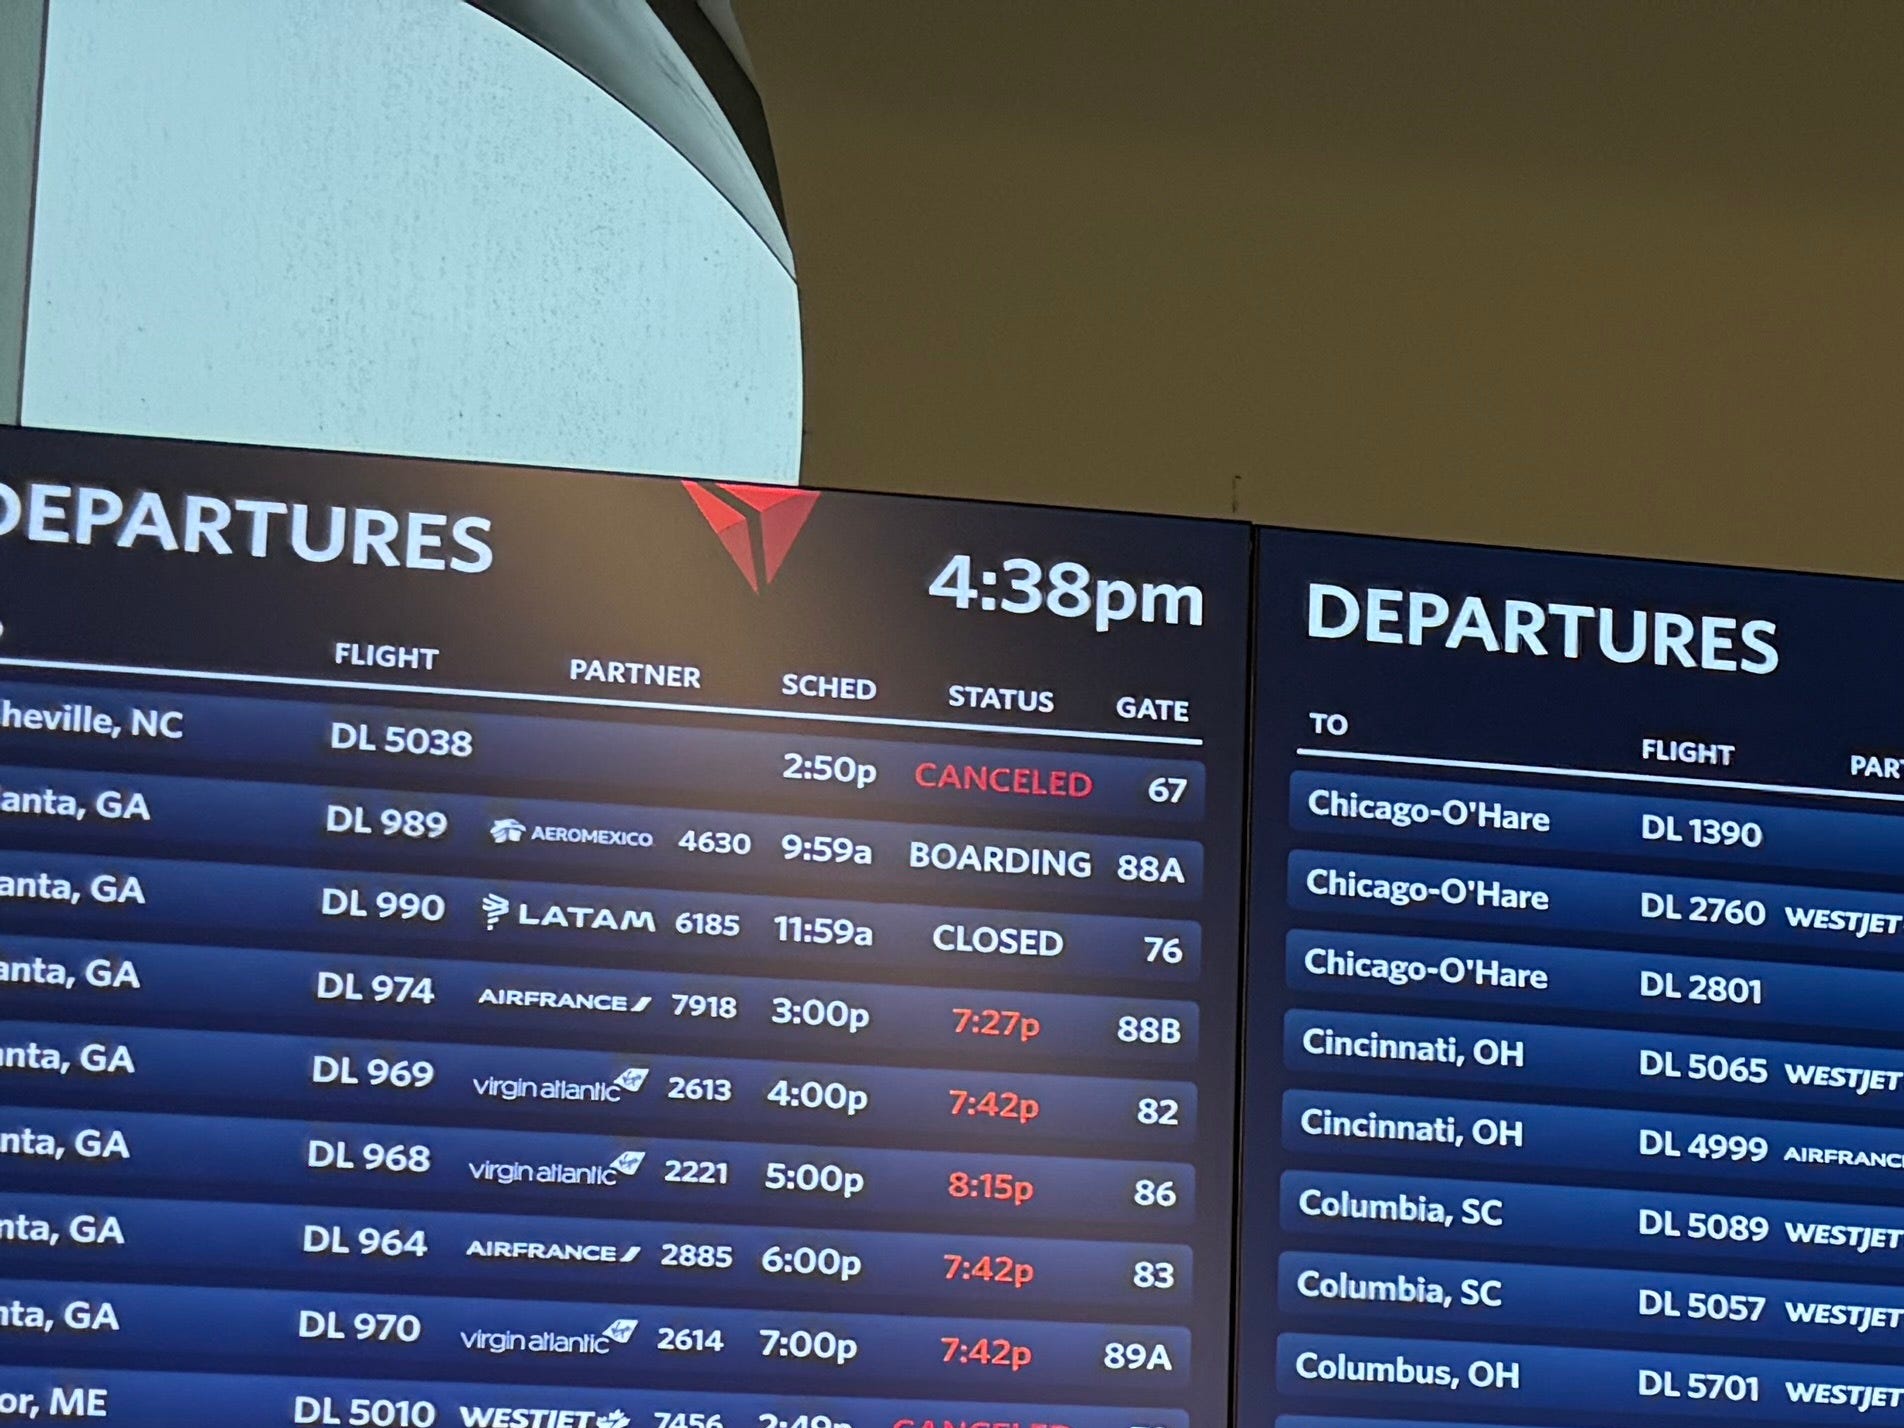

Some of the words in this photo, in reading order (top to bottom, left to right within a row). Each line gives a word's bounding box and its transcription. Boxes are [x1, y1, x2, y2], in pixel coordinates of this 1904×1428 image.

[929, 555, 1202, 632] 4:38pm
[1309, 583, 1778, 674] DEPARTURES
[336, 643, 439, 670] FLIGHT
[571, 659, 700, 688] PARTNER
[782, 674, 876, 699] SCHED
[949, 685, 1054, 712] STATUS
[1117, 697, 1189, 722] GATE
[332, 722, 376, 750] DL
[385, 727, 472, 757] 5038
[783, 753, 876, 788] 2:50p
[915, 762, 1092, 797] CANCELED
[1149, 778, 1187, 803] 67
[1309, 713, 1348, 735] TO
[1643, 739, 1735, 765] FLIGHT
[327, 805, 371, 833] DL
[381, 809, 447, 838] 989
[531, 826, 653, 847] AEROMEXICO
[678, 830, 751, 854] 4630
[782, 834, 871, 864] 9:59a
[910, 842, 1091, 877] BOARDING
[1118, 855, 1185, 883] 88A
[519, 904, 655, 932] LATAM
[1303, 1028, 1464, 1067] Cincinnati,
[1474, 1039, 1523, 1067] OH
[1640, 1050, 1681, 1077] DL
[1688, 1054, 1767, 1083] 5065
[1785, 1064, 1904, 1095] WESTJET
